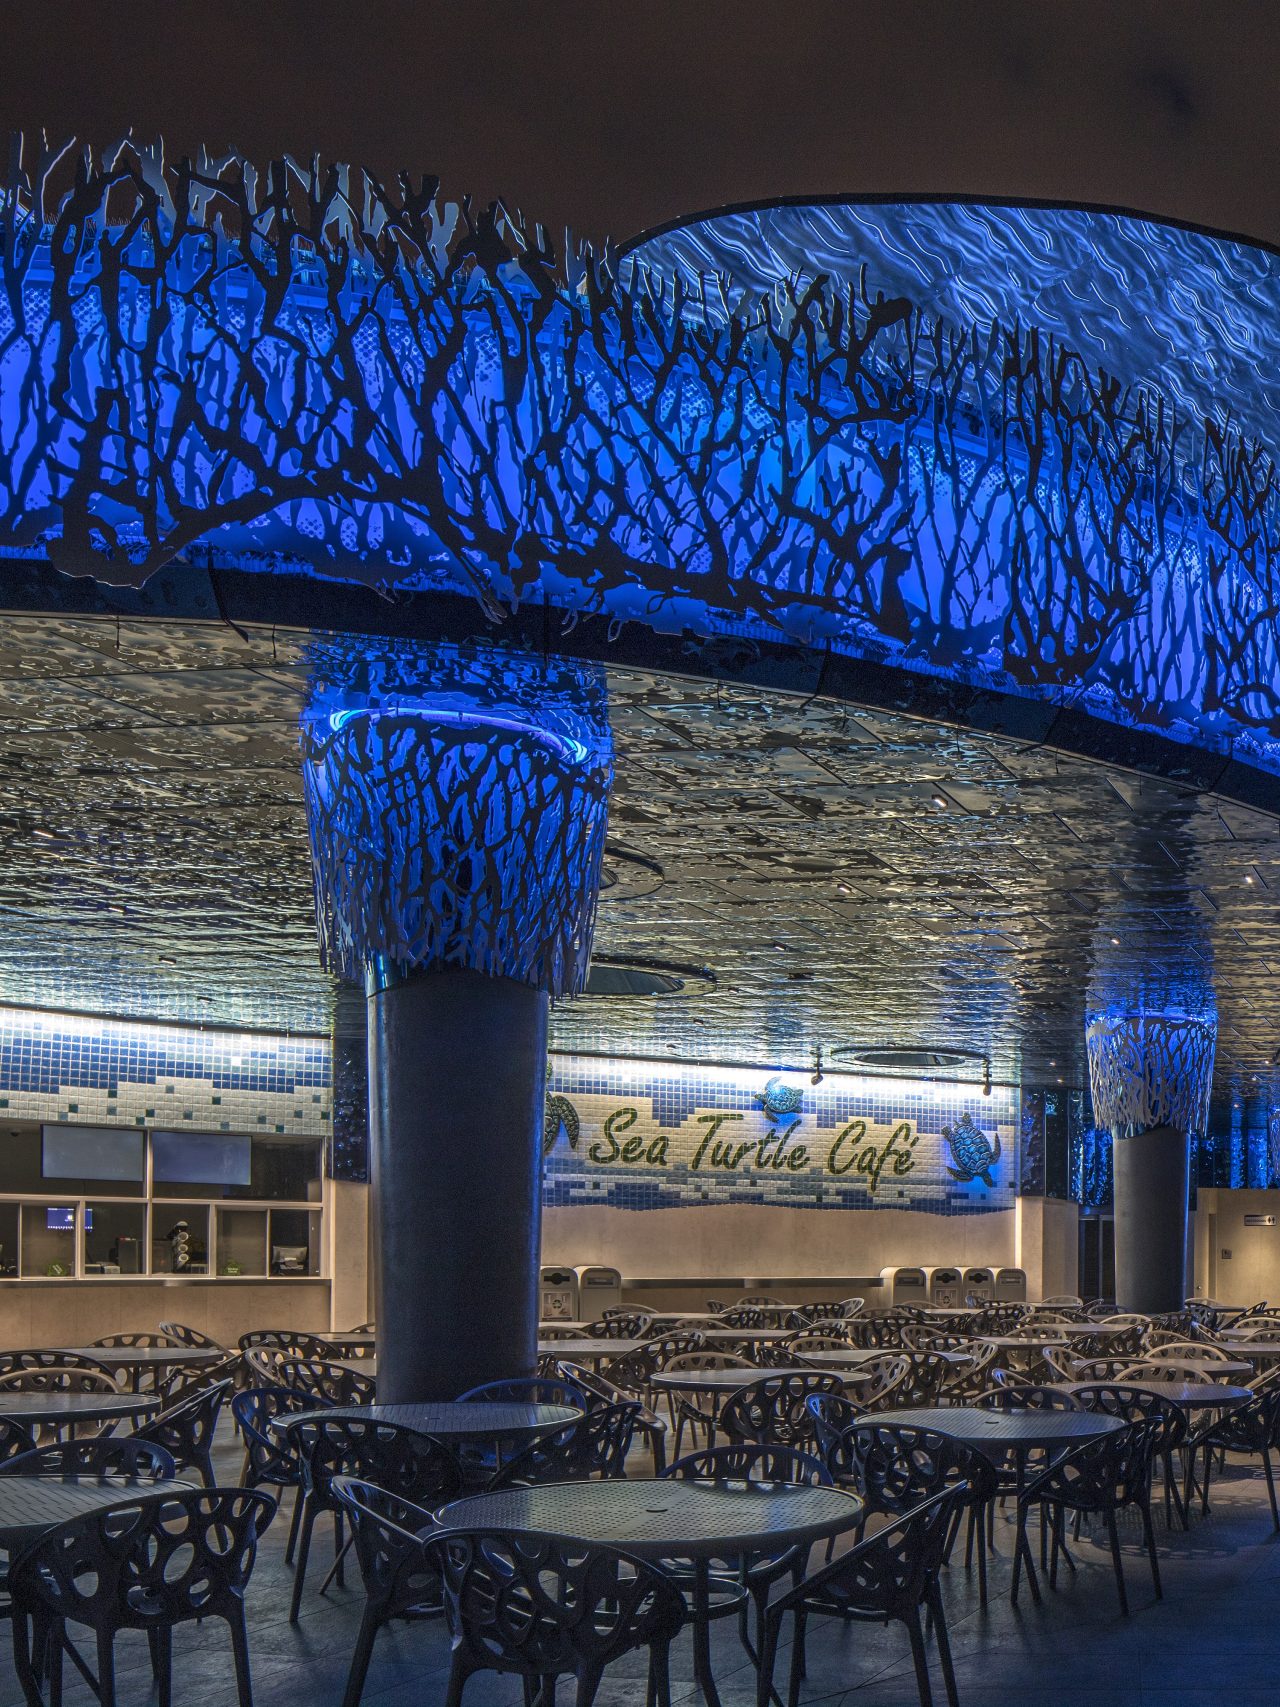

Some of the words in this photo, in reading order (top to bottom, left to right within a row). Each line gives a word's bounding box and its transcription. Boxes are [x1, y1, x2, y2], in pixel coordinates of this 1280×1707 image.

[588, 1107, 670, 1166] Sea
[691, 1113, 810, 1171] Turtle
[828, 1120, 919, 1192] Café
